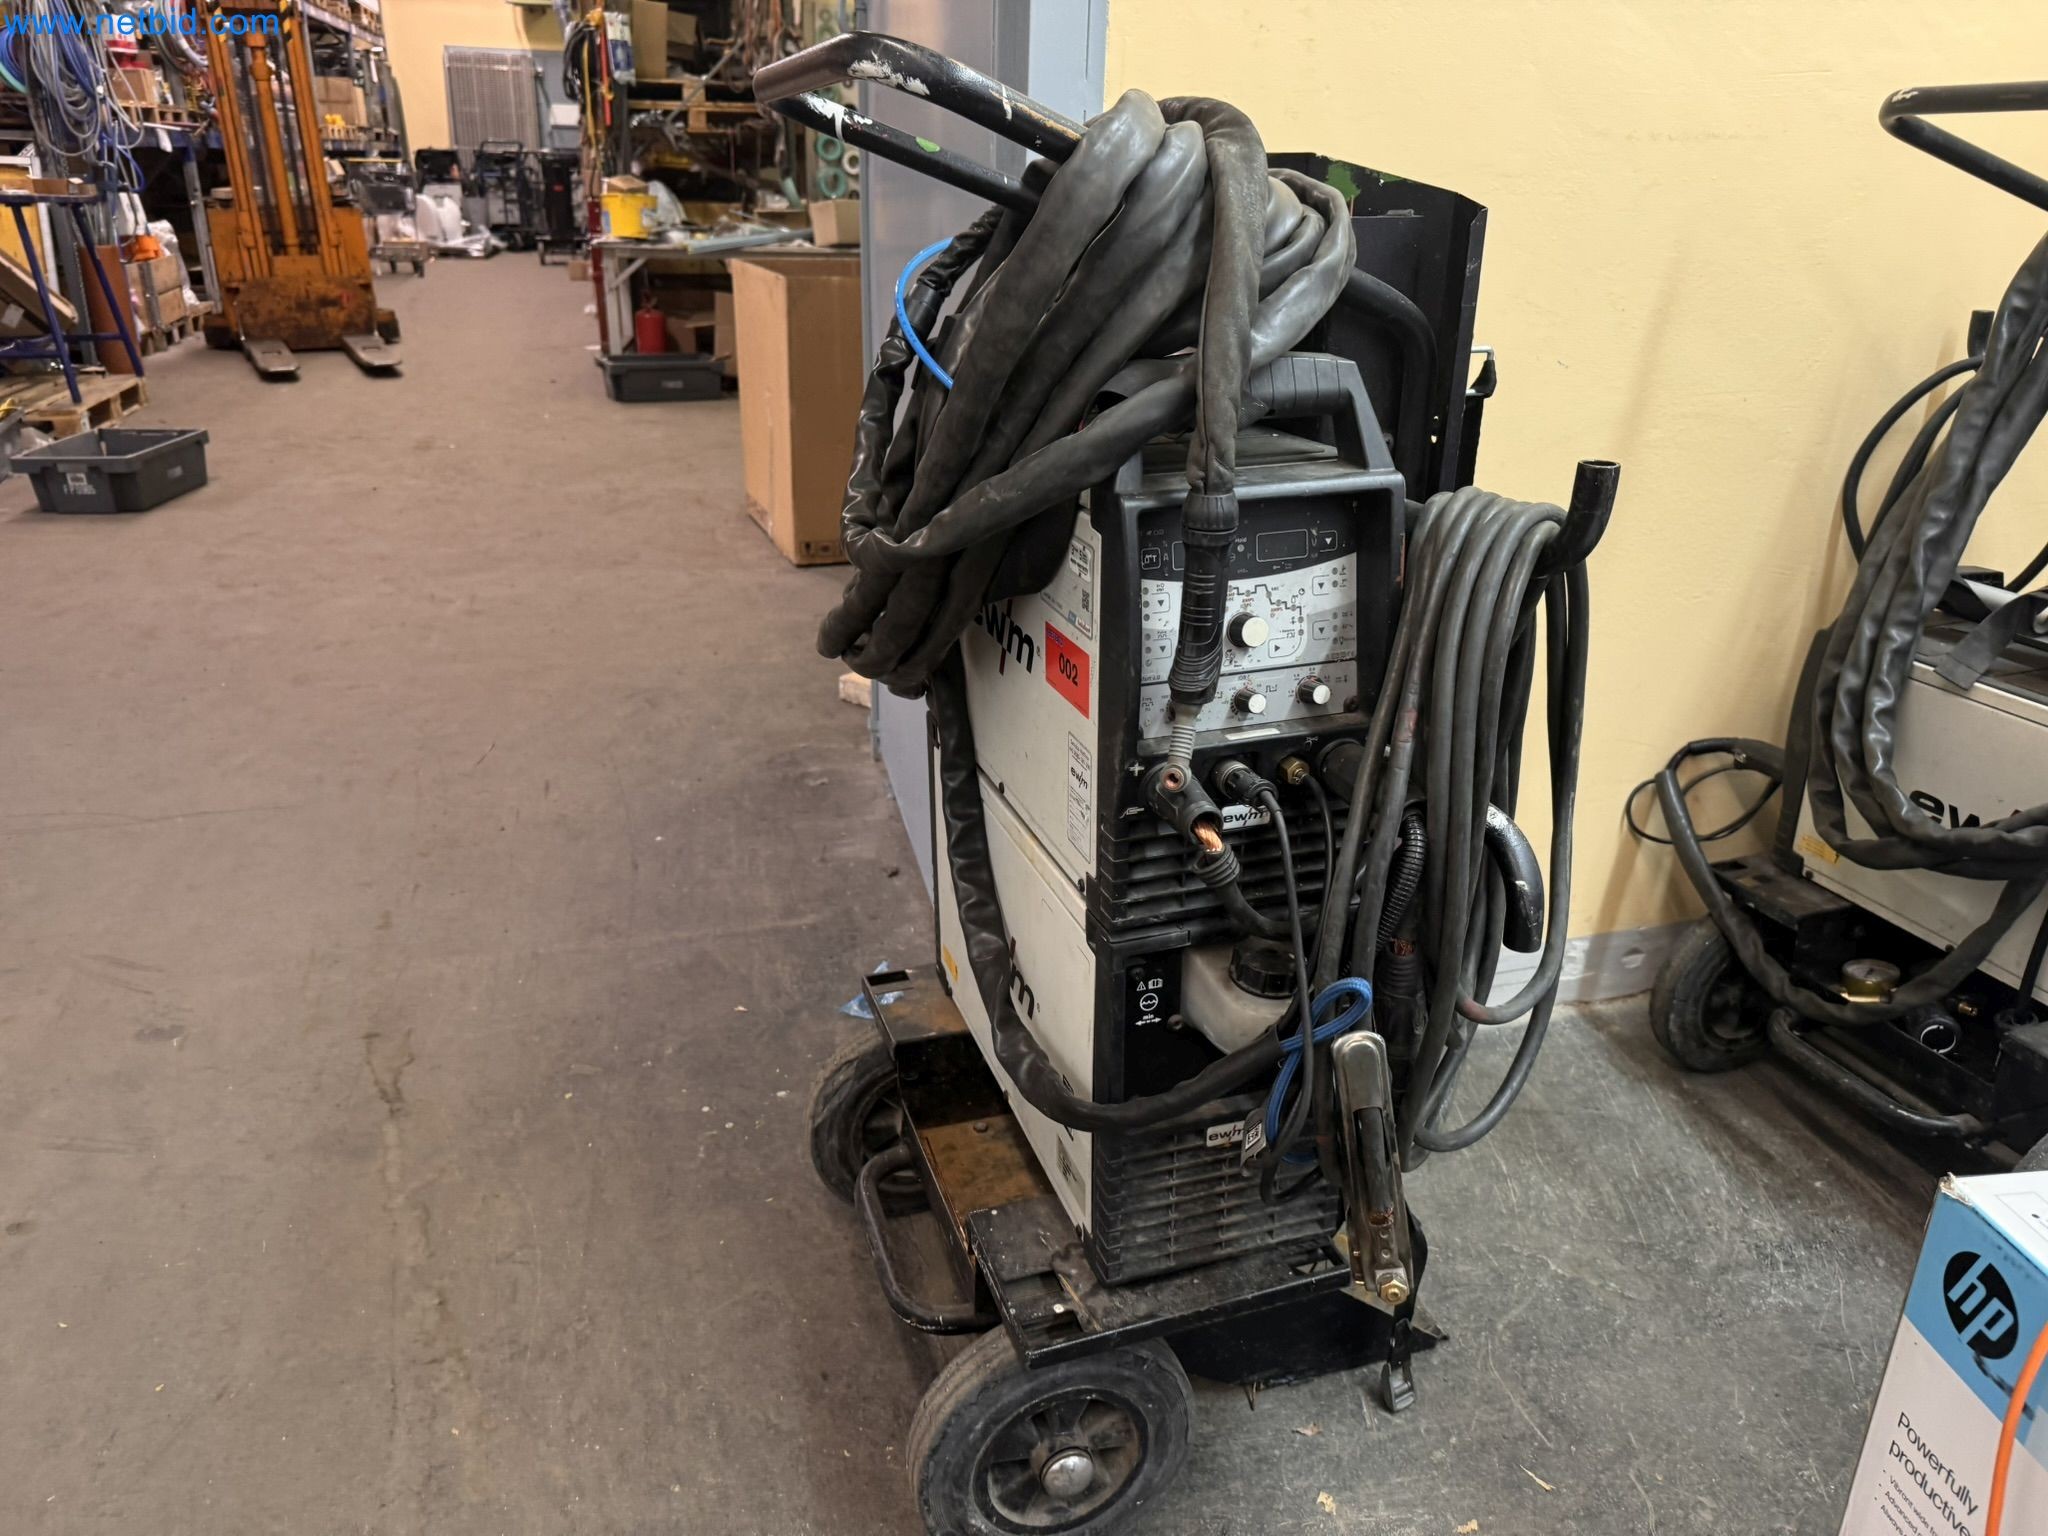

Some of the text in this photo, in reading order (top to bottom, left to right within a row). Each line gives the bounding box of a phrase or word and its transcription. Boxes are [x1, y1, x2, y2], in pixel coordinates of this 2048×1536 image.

[1058, 652, 1078, 687] 002
[1223, 807, 1264, 826] ewm
[1944, 1251, 2017, 1357] hp
[1897, 1411, 1979, 1516] Powerfully
[1888, 1440, 1971, 1536] productive
[1889, 1475, 1914, 1509] Vibrant
[1884, 1490, 1918, 1534] Advanced
